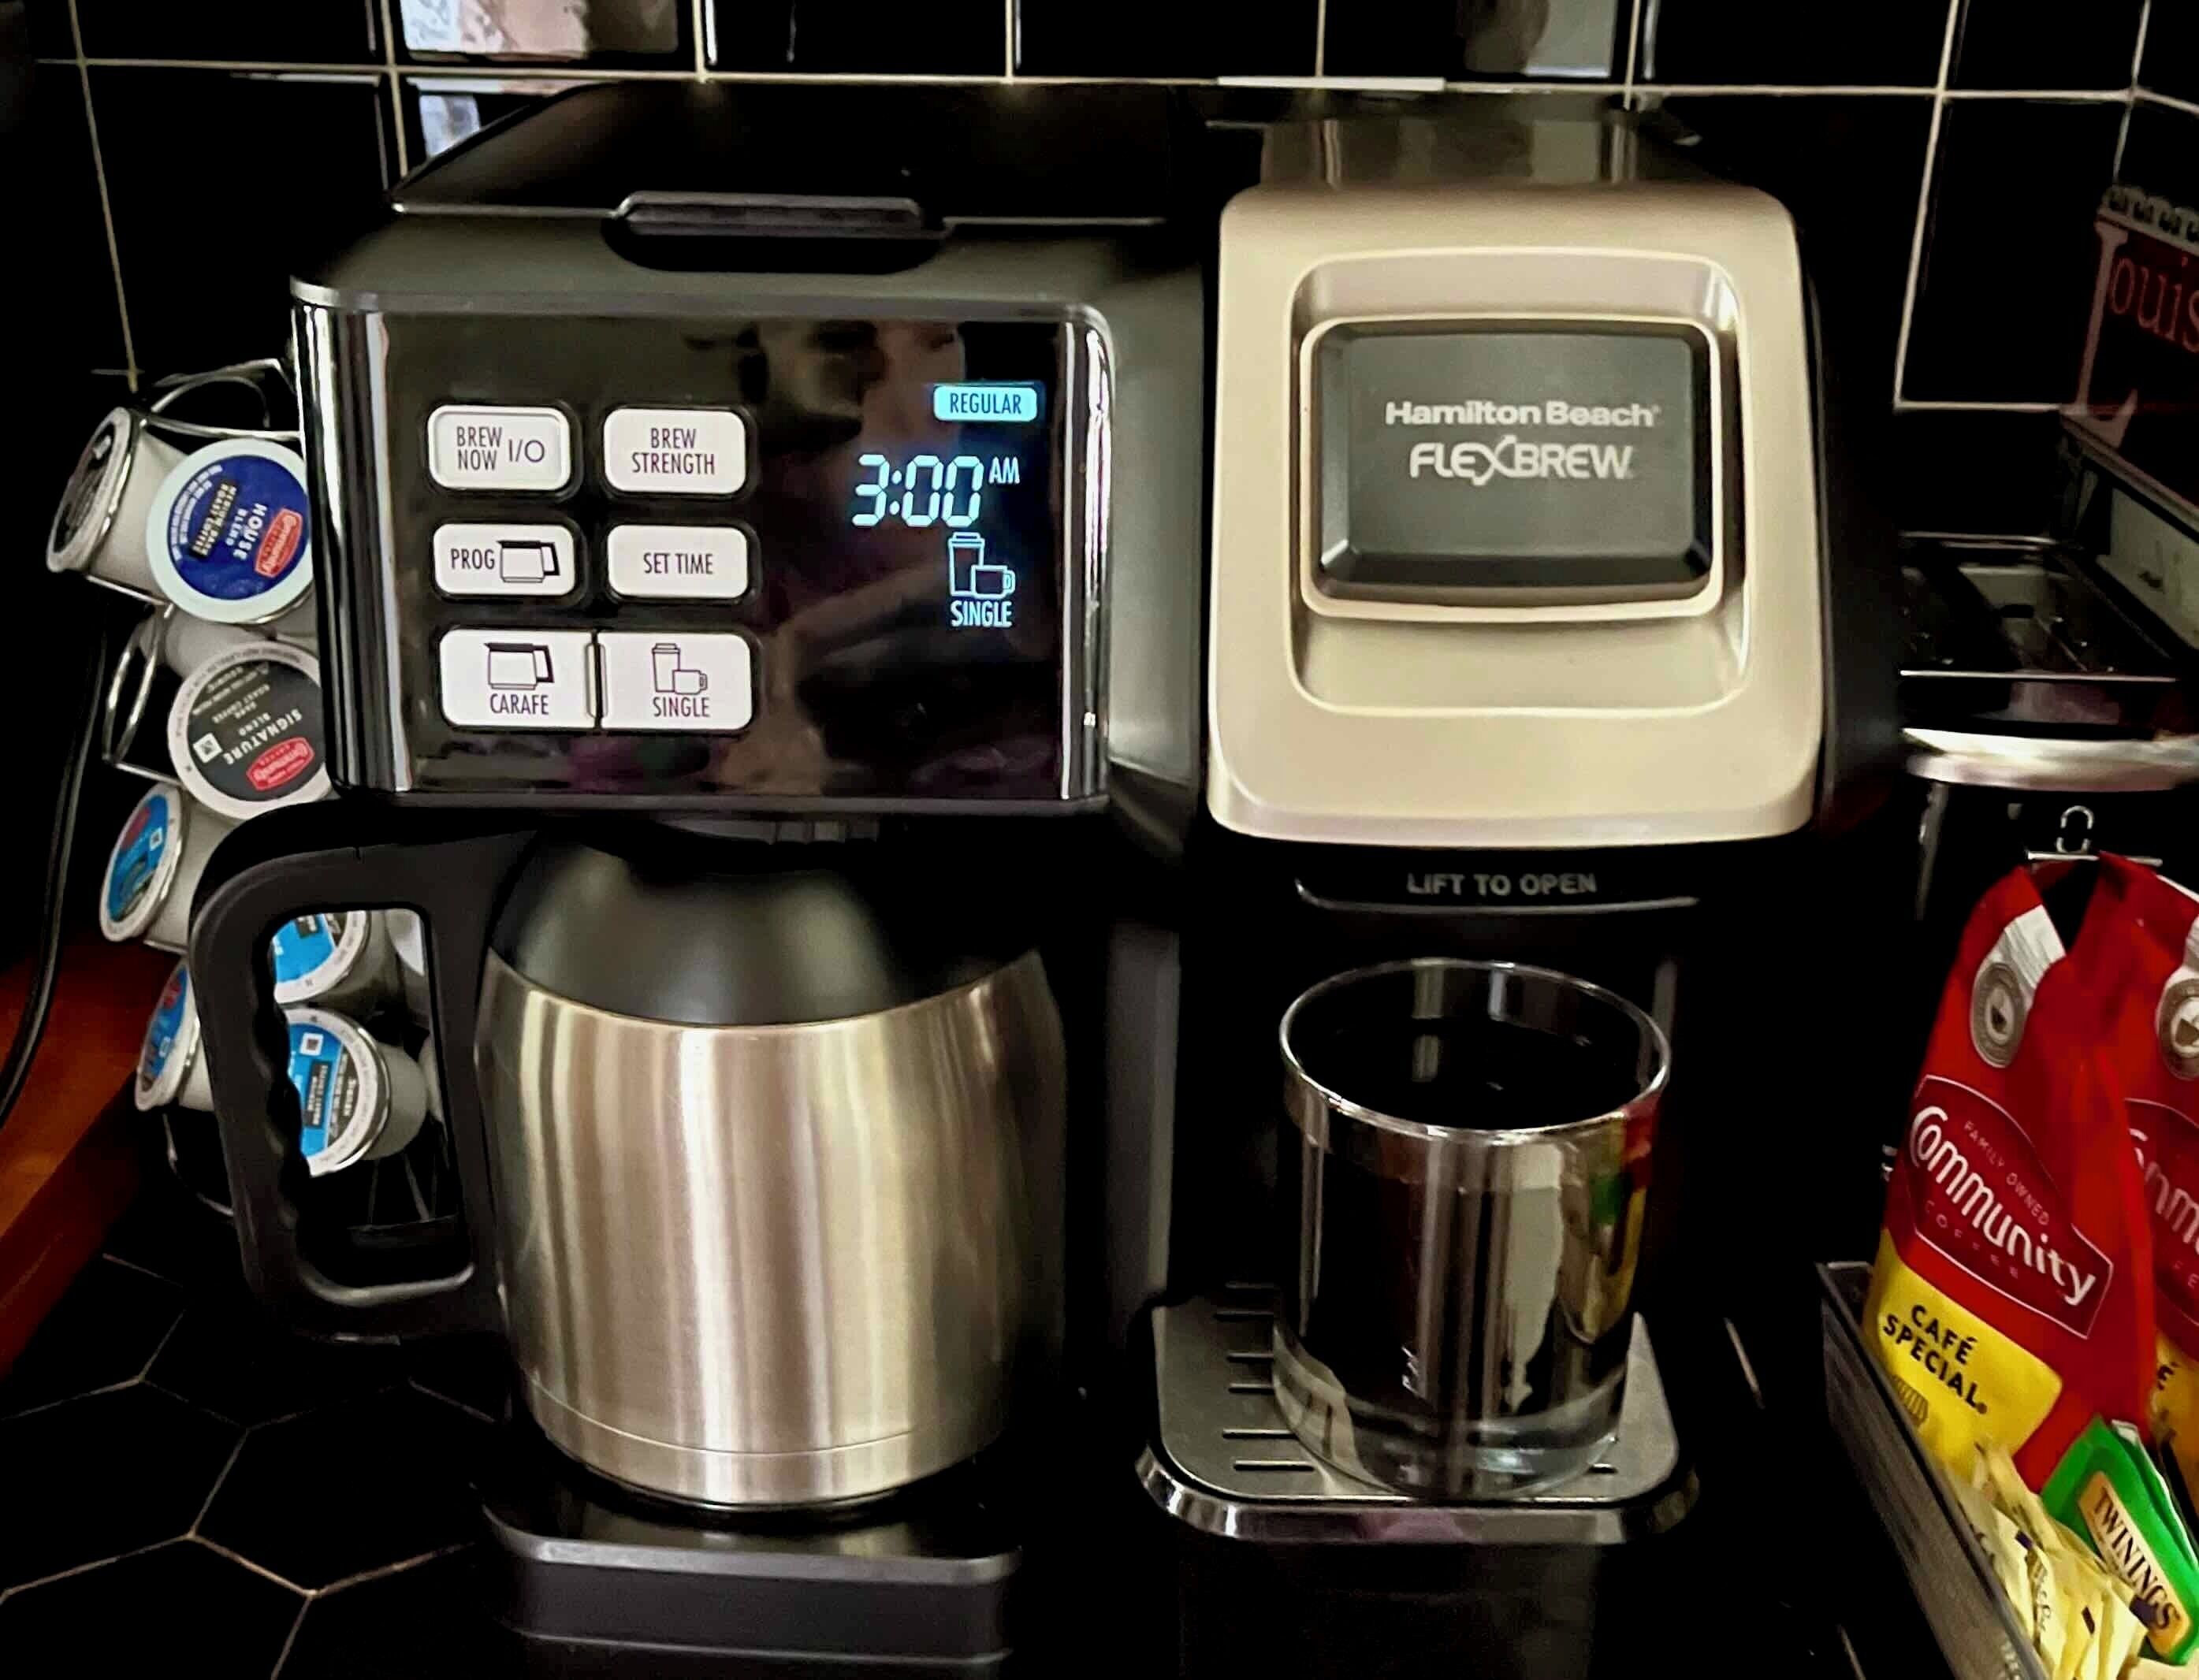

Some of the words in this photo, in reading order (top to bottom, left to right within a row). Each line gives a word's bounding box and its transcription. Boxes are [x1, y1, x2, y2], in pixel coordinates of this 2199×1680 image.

[950, 392, 1021, 414] REGULAR
[1385, 400, 1542, 426] Hamilton
[456, 426, 503, 448] BREW
[650, 427, 697, 449] BREW
[457, 449, 497, 471] NOW
[631, 452, 716, 476] STRENGTH
[1409, 434, 1634, 486] FLEXBREW
[852, 454, 984, 527] 3:00
[988, 456, 1021, 485] AM
[233, 503, 267, 559] HOUSE
[450, 548, 496, 571] PROG
[643, 552, 671, 574] SET
[675, 552, 714, 574] TIME
[950, 600, 1012, 628] SINGLE
[489, 693, 549, 715] CARAFE
[653, 697, 710, 718] SINGLE
[222, 708, 303, 765] SIGNATURE
[1407, 872, 1465, 896] LIFT
[1473, 873, 1512, 896] TO
[1519, 872, 1598, 896] OPEN
[1963, 1121, 2005, 1168] FAMILY
[2006, 1172, 2049, 1226] OWNED
[1910, 1106, 2097, 1306] Community
[1911, 1304, 1978, 1365] CAFÉ
